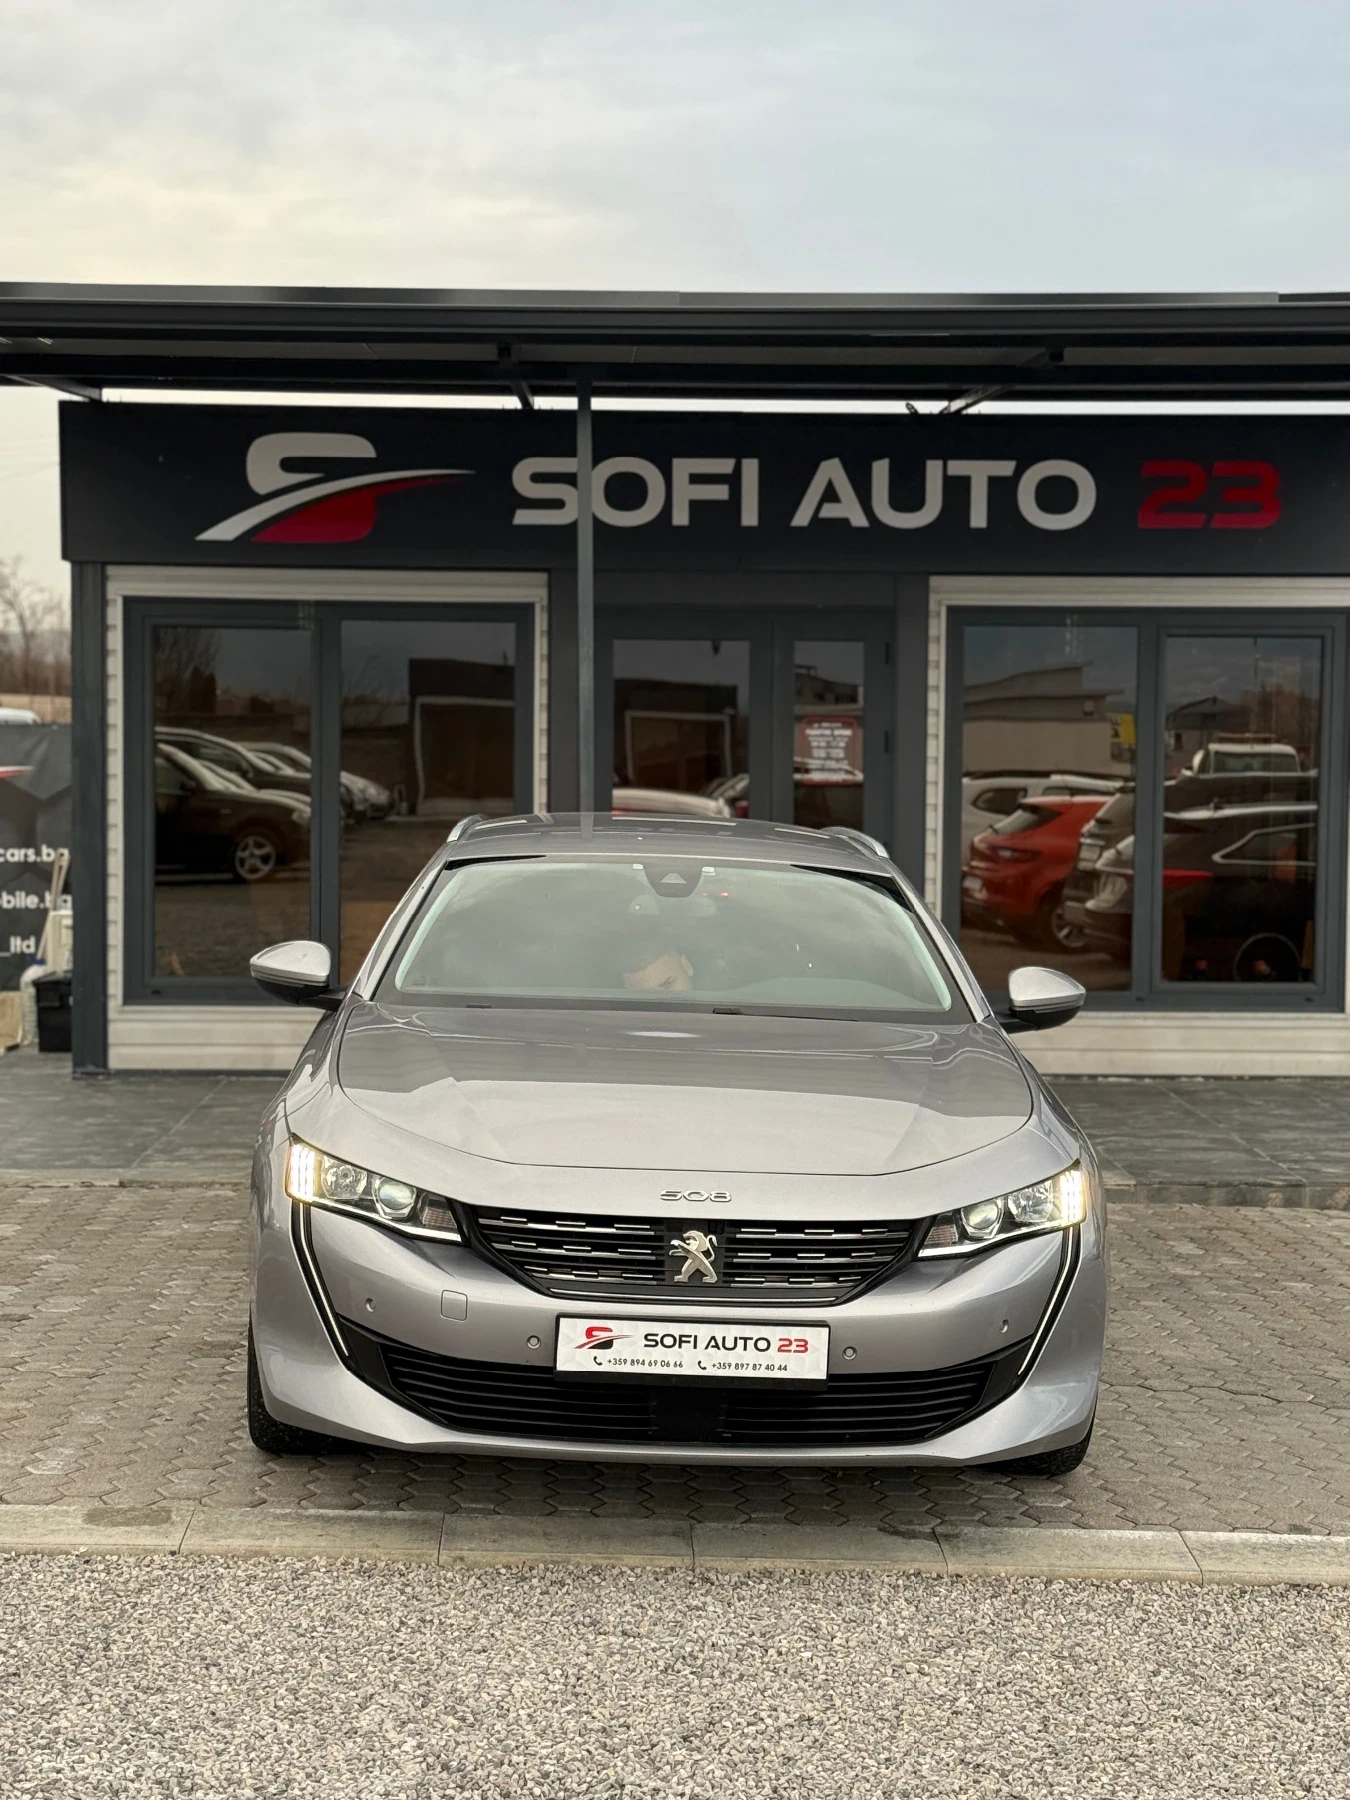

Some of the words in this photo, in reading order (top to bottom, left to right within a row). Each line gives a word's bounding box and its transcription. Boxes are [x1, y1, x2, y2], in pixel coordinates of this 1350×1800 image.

[511, 456, 760, 528] SOFI
[789, 457, 1098, 531] AUTO
[1137, 460, 1282, 529] 23
[660, 1190, 732, 1203] 508
[643, 1332, 698, 1350] SOFI
[704, 1335, 771, 1353] AUTO
[777, 1338, 809, 1354] 23
[607, 1357, 628, 1366] +359
[630, 1358, 646, 1367] 894
[648, 1359, 658, 1368] 69
[660, 1359, 671, 1368] 06
[673, 1360, 684, 1369] 66
[711, 1361, 732, 1370] +359
[734, 1362, 750, 1371] 897
[752, 1363, 763, 1372] 87
[764, 1363, 776, 1372] 40
[777, 1364, 788, 1372] 44
